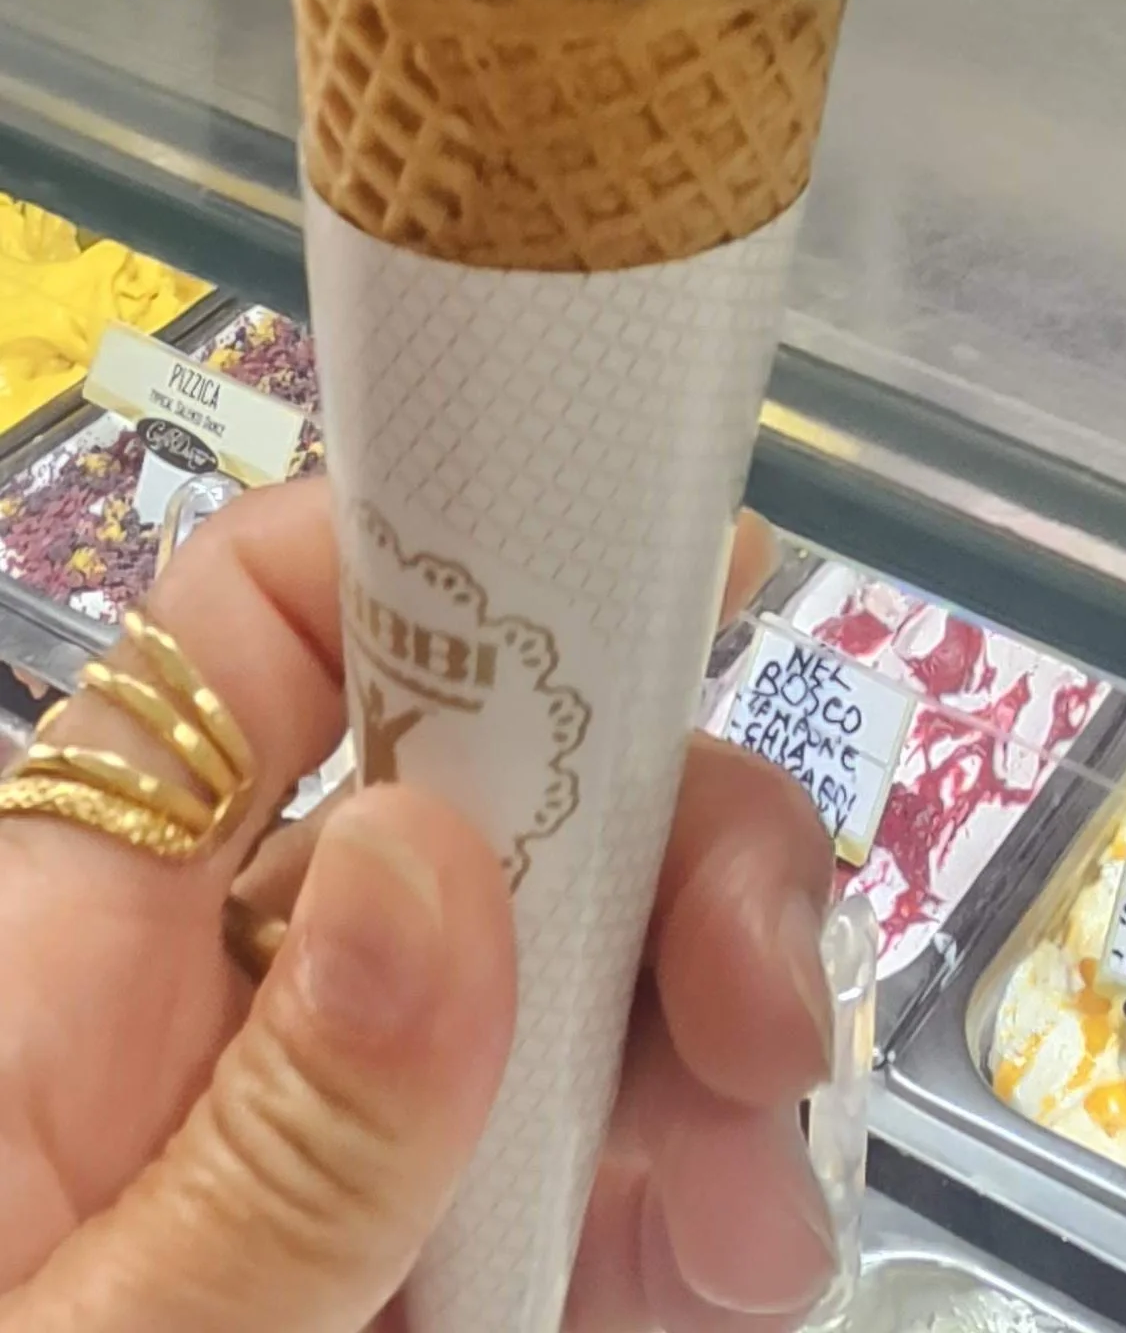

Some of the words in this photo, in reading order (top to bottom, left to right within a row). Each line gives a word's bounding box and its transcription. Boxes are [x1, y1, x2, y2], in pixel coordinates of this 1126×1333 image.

[168, 362, 221, 410] PIZZICA
[786, 646, 852, 691] NEL
[753, 661, 862, 735] BOSCO
